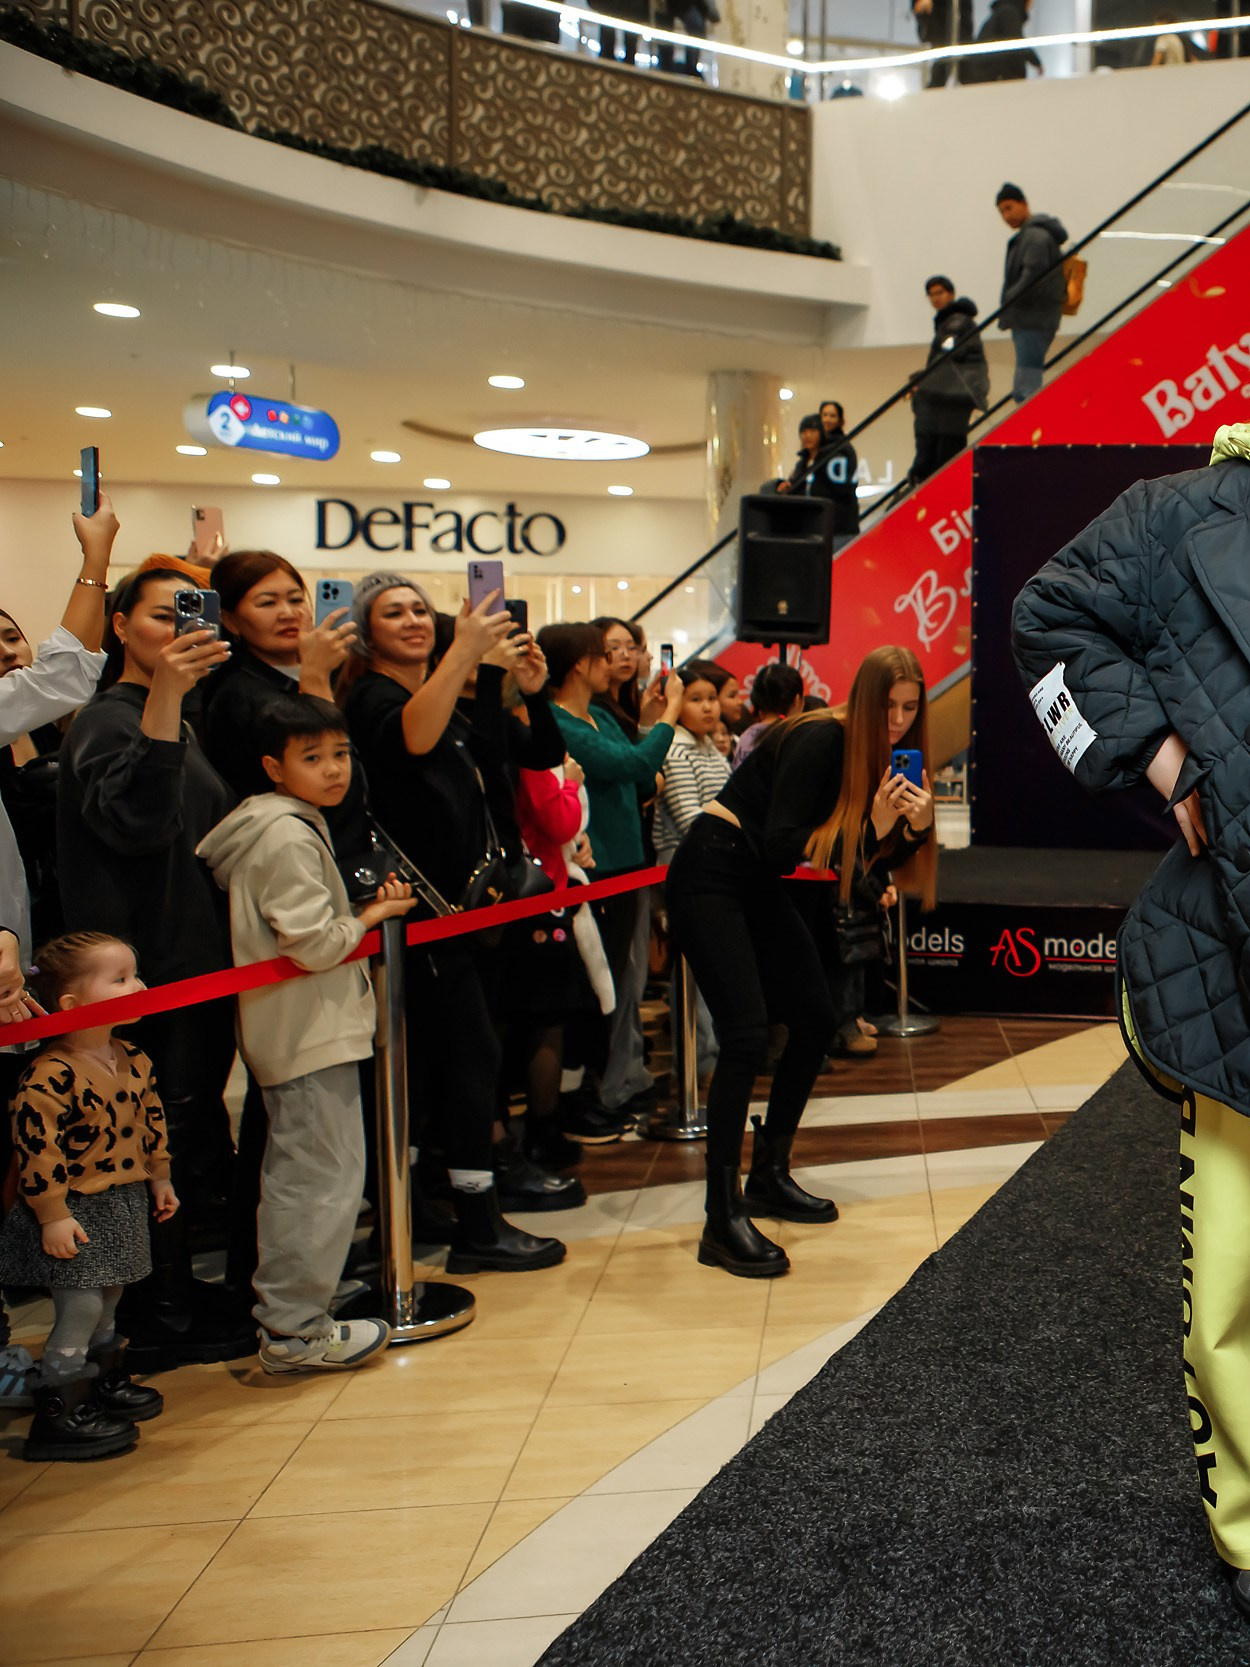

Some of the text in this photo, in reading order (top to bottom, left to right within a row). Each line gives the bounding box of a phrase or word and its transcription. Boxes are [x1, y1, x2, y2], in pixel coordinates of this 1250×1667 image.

[315, 499, 566, 557] DeFacto
[1041, 691, 1071, 735] LWR
[905, 926, 964, 953] dels
[990, 927, 1116, 977] AS mode
